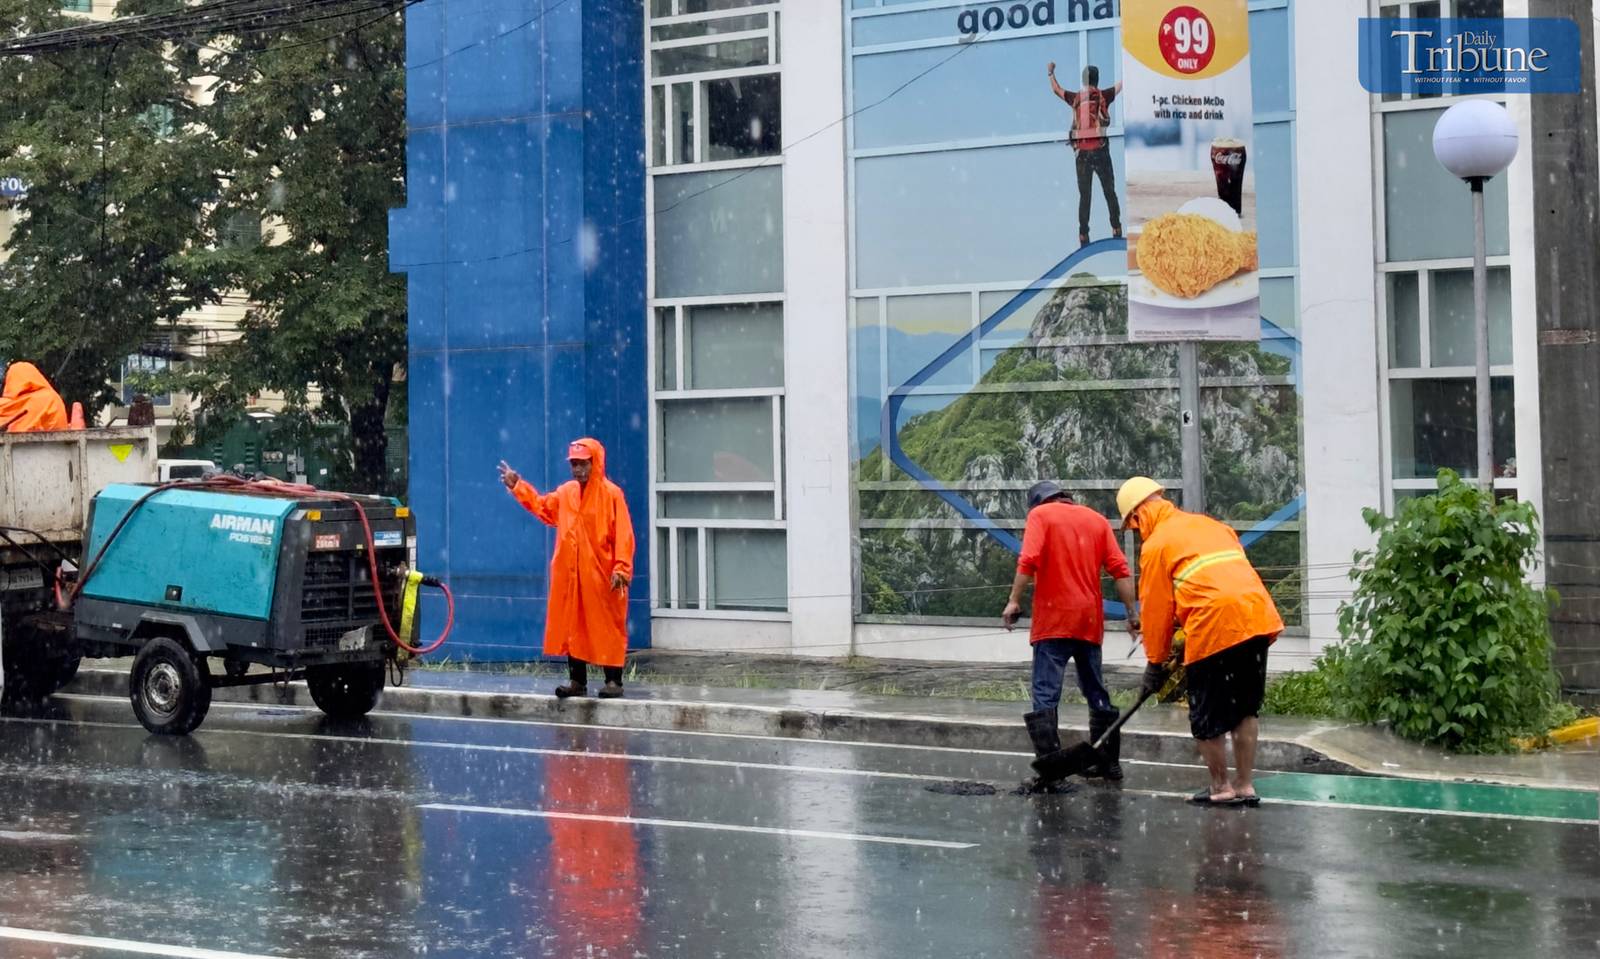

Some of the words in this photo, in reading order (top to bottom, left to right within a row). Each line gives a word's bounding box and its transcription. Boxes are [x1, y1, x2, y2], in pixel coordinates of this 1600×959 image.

[957, 0, 1055, 44] good
[1177, 58, 1199, 69] ONLY
[1172, 95, 1202, 106] Chicken
[1203, 96, 1225, 106] McDo
[1154, 108, 1171, 119] with
[1172, 109, 1187, 119] rice
[1188, 109, 1202, 119] and
[1204, 109, 1224, 120] drink
[210, 513, 275, 534] AIRMAN
